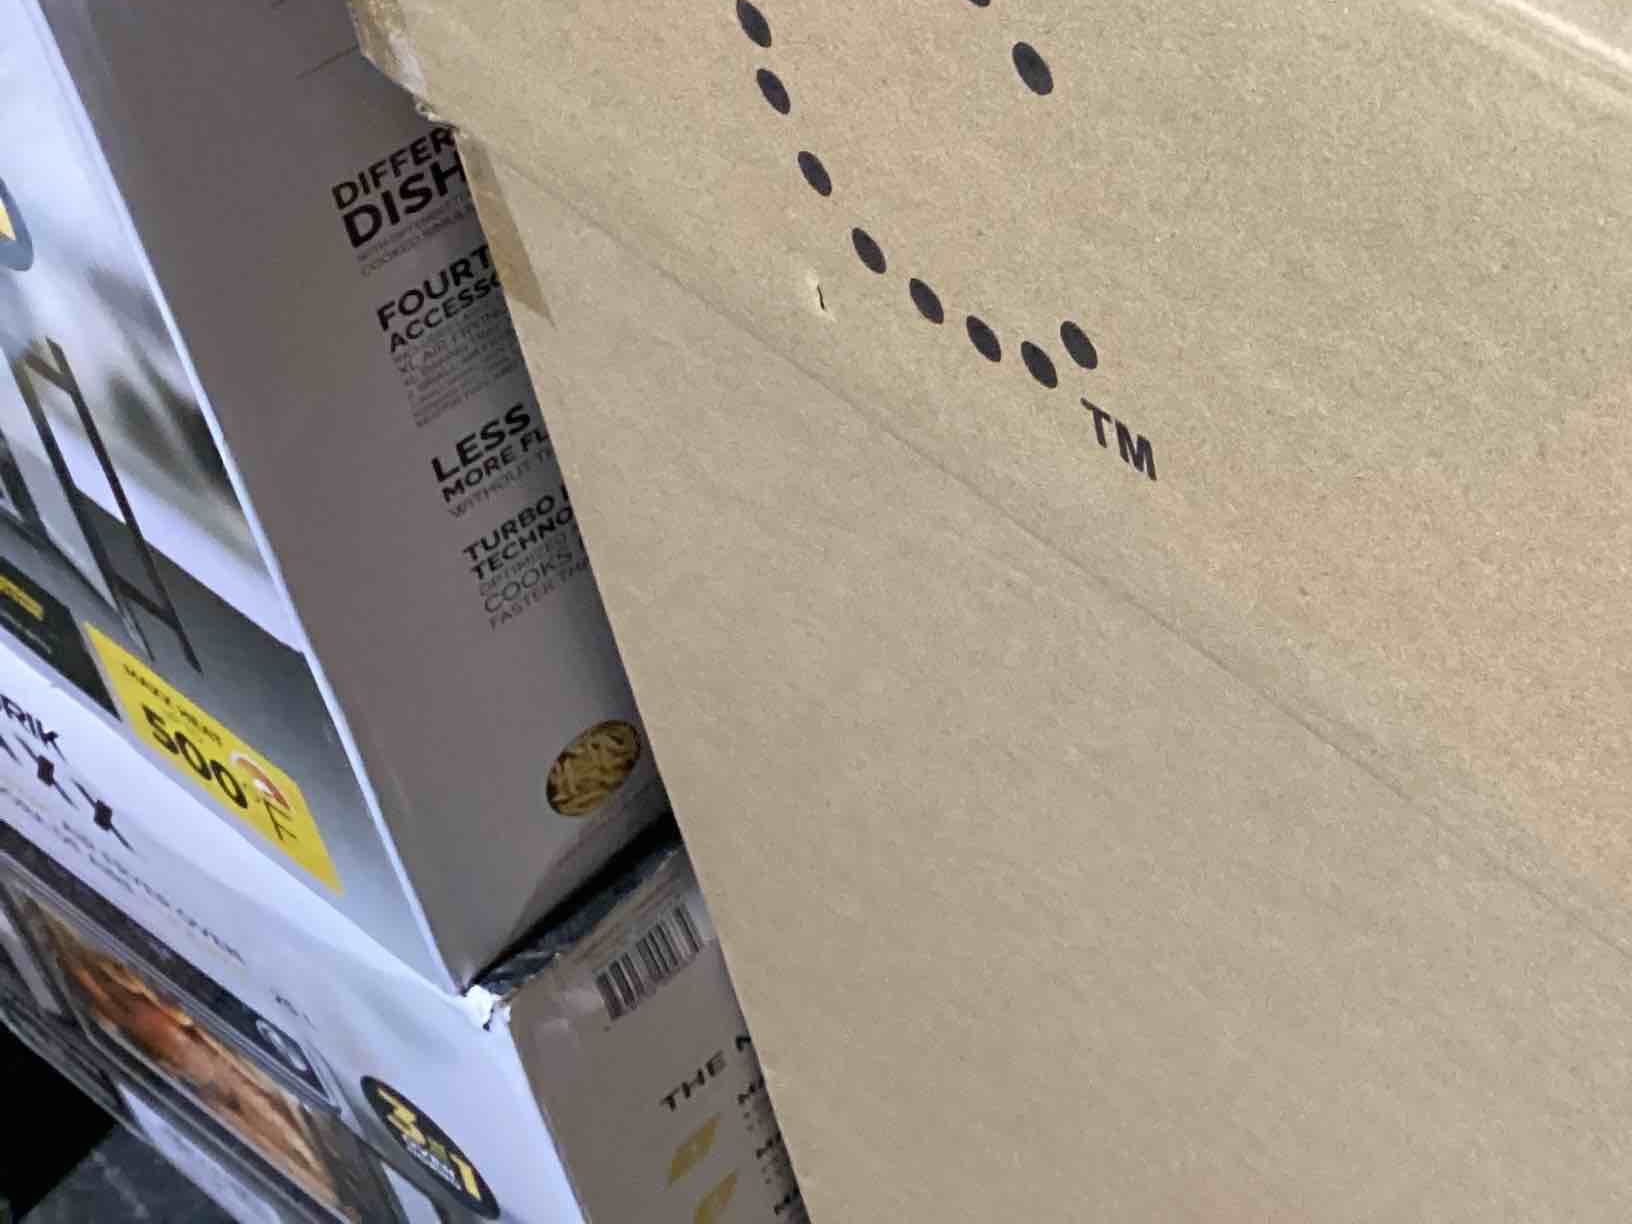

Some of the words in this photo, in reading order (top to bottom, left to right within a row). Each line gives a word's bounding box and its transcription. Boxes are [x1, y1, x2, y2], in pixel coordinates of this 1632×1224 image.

[331, 127, 455, 210] DIFFER
[342, 161, 467, 249] DISH
[376, 244, 490, 331] FOURT
[431, 402, 531, 483] LESS
[441, 446, 514, 503] MORE
[1079, 397, 1157, 481] TM
[463, 494, 555, 561] TURBO
[470, 505, 573, 580] TECHNO
[659, 1050, 728, 1112] THE
